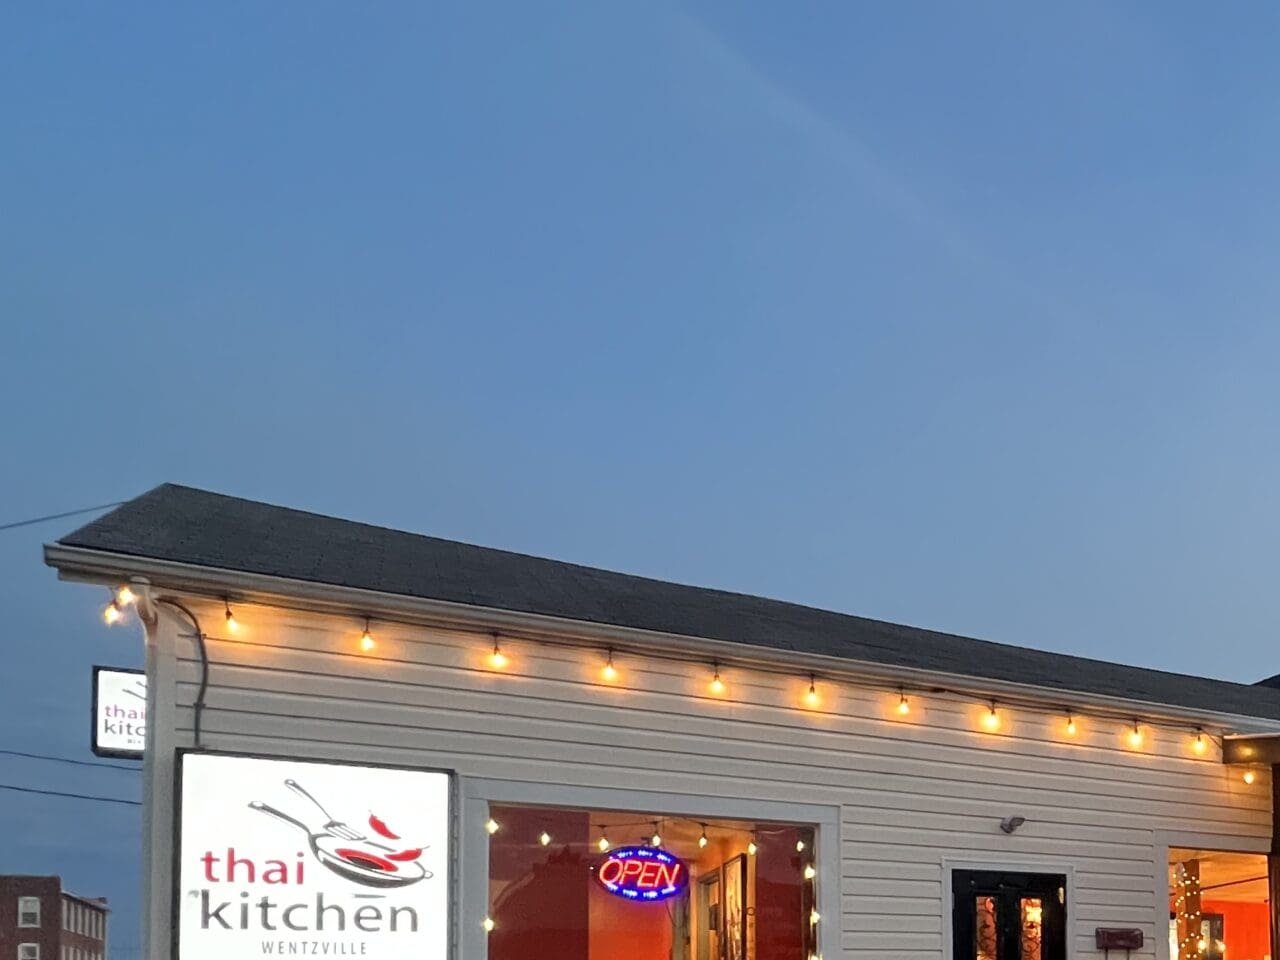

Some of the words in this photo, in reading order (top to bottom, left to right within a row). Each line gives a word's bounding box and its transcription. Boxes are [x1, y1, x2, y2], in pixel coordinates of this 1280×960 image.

[104, 718, 147, 736] kitc
[201, 847, 305, 885] thai
[599, 858, 681, 888] OPEN
[261, 940, 367, 955] WENTZVILLE
